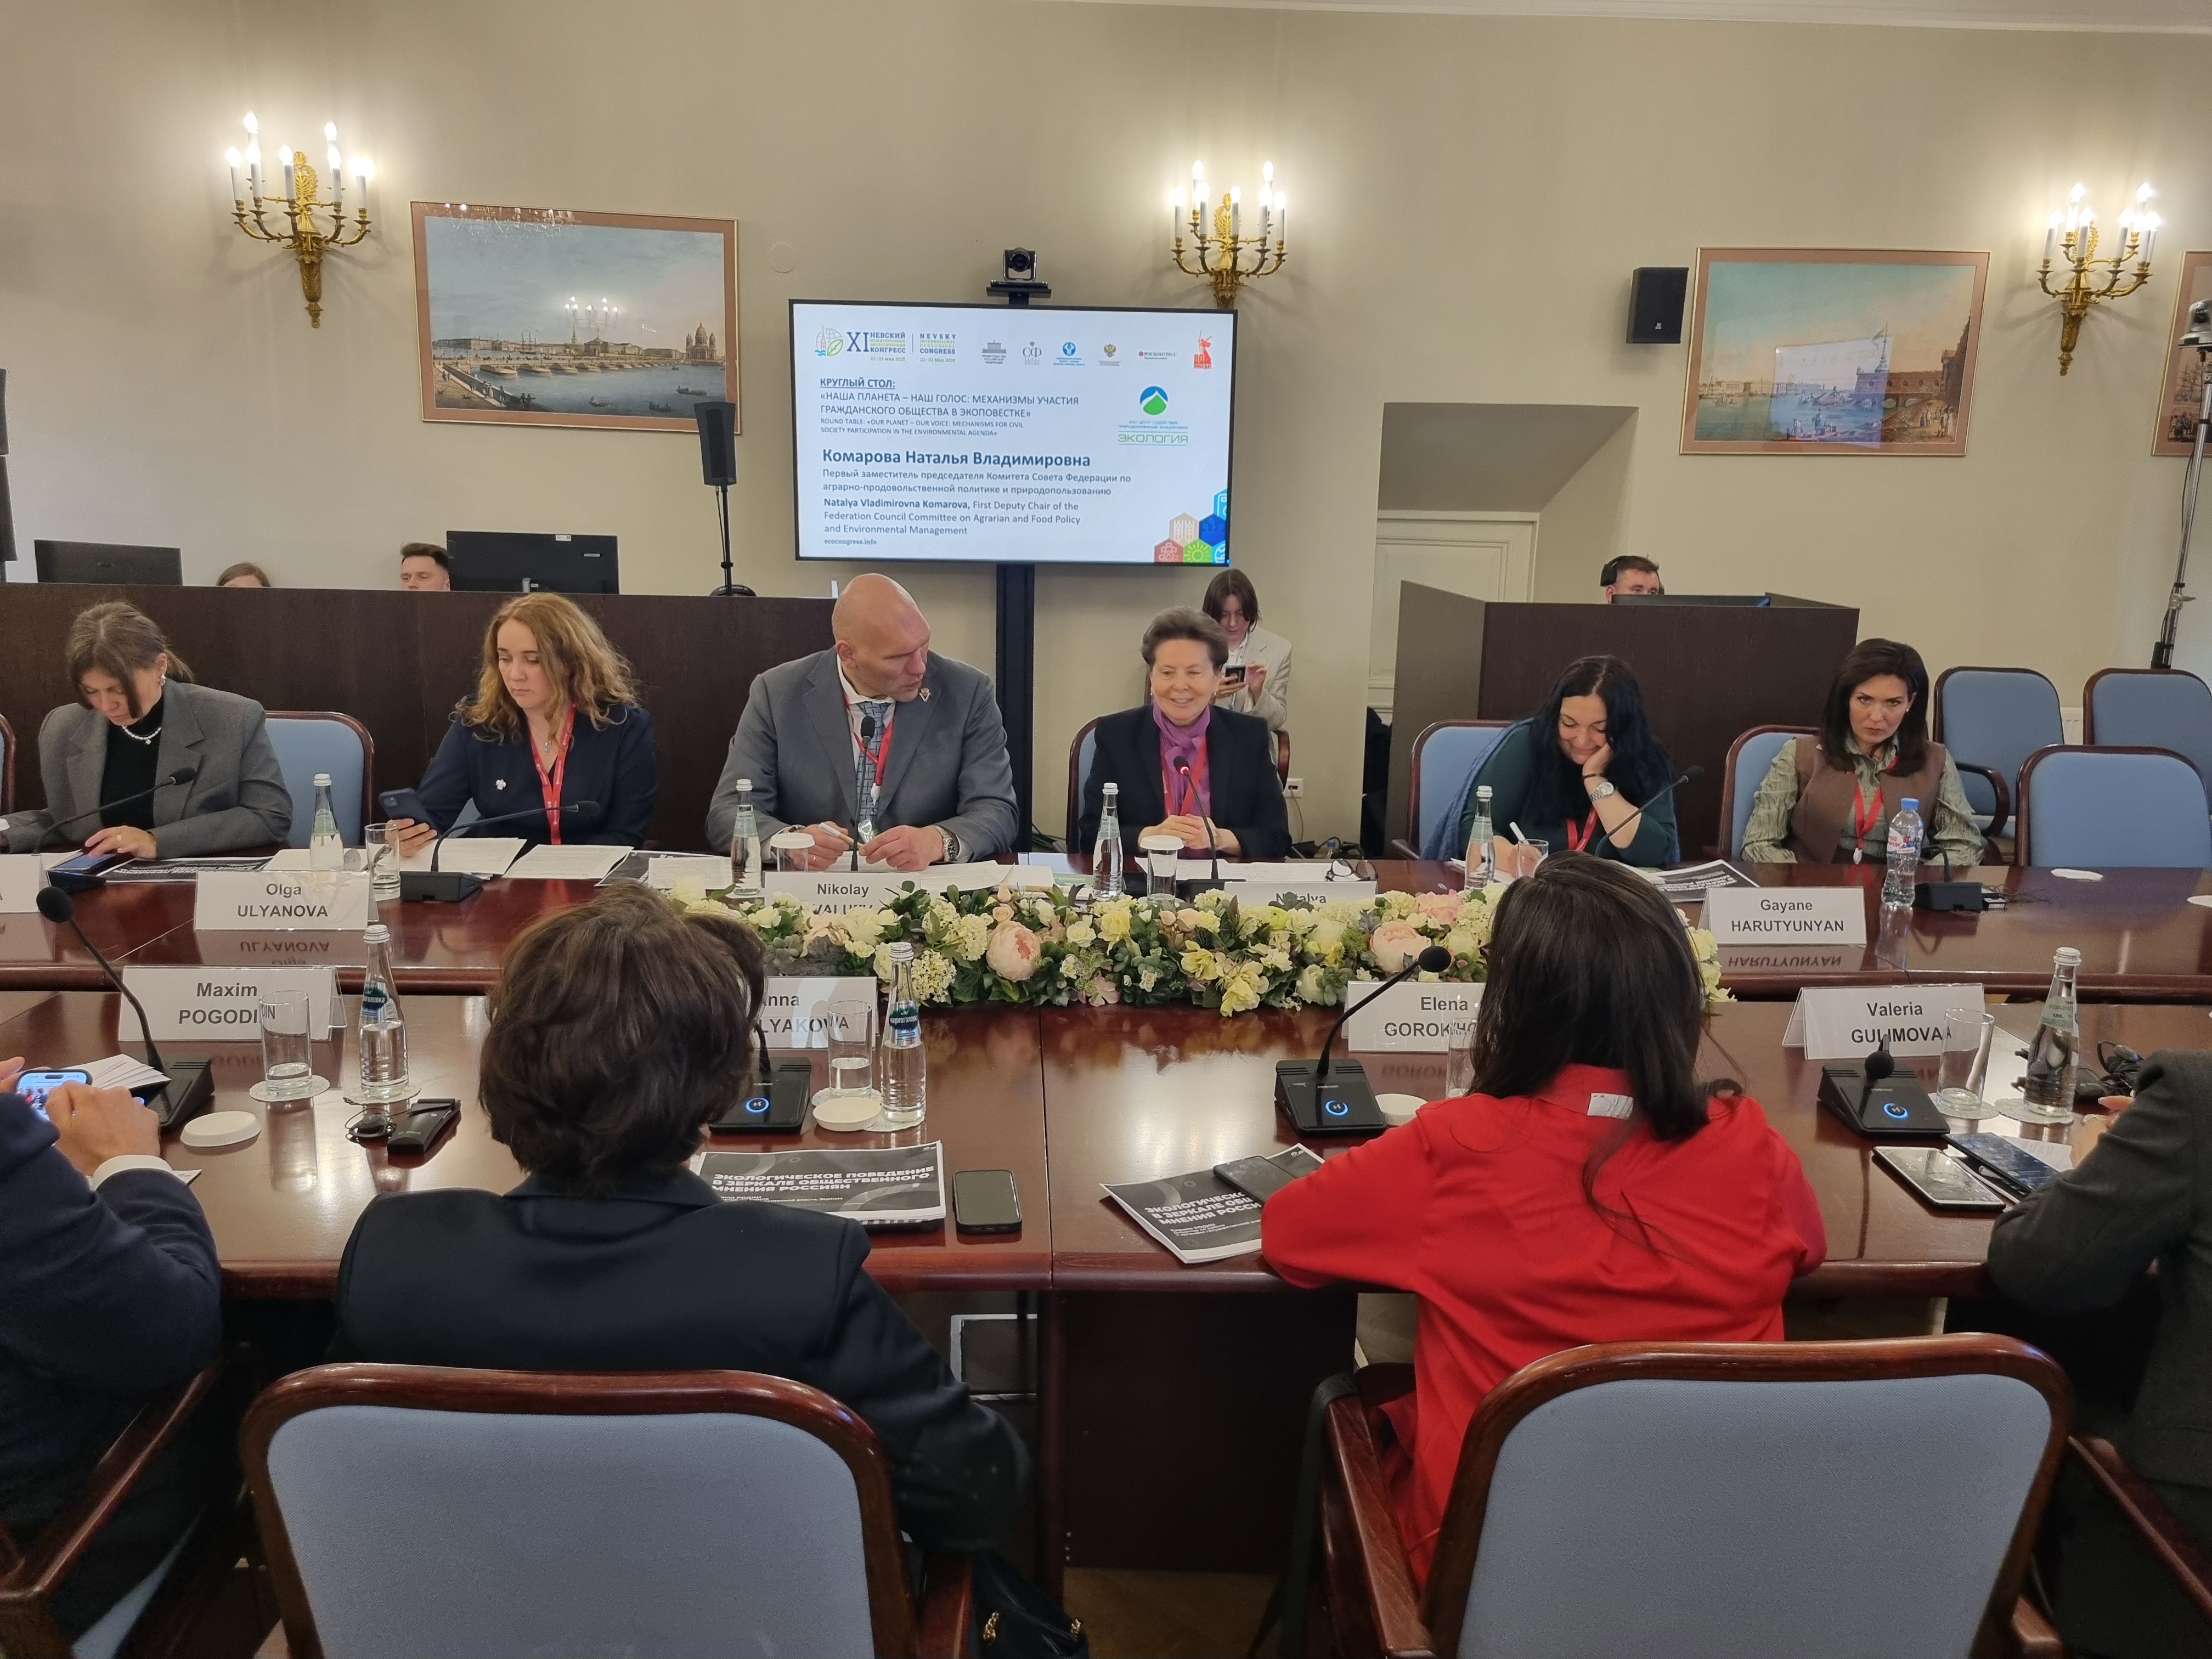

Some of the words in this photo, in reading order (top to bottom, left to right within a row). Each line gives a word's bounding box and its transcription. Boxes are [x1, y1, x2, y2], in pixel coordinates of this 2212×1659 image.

[847, 332, 869, 352] XI
[820, 377, 865, 387] КРУГЛЫЙ
[867, 379, 895, 388] СТОЛ:
[821, 392, 855, 400] «НАША
[857, 393, 900, 402] ПЛАНЕТА
[911, 394, 933, 402] НАШ
[936, 394, 969, 403] ГОЛОС:
[972, 396, 1035, 404] МЕХАНИЗМЫ
[1037, 397, 1079, 405] УЧАСТИЯ
[821, 405, 895, 415] ГРАЖДАНСКОГО
[898, 407, 949, 417] ОБЩЕСТВА
[960, 408, 1031, 417] ЭКОПОВЕСТКЕ»
[1118, 434, 1188, 444] ЭКОЛОГИЯ
[823, 449, 901, 465] Комарова
[906, 450, 968, 465] Наталья
[973, 452, 1091, 469] Владимировна
[823, 469, 859, 479] Первый
[861, 471, 918, 479] заместитель
[921, 472, 984, 481] председателя
[987, 472, 1029, 481] Комитета
[1032, 473, 1063, 481] Совета
[1065, 473, 1118, 483] Федерации
[823, 483, 955, 493] аграрно-продовольственной
[958, 486, 1000, 494] политике
[1011, 487, 1111, 496] природопользованию
[824, 498, 858, 508] Natalya
[861, 499, 920, 508] Vladimirovna
[923, 500, 970, 510] Komarova,
[973, 501, 991, 510] First
[994, 501, 1025, 511] Deputy
[1028, 501, 1051, 510] Chair
[1053, 502, 1063, 510] of
[1064, 502, 1079, 510] the
[824, 512, 871, 520] Federation
[874, 512, 906, 521] Council
[909, 512, 957, 522] Committee
[973, 514, 1010, 523] Agrarian
[1013, 515, 1029, 523] and
[1031, 515, 1053, 523] Food
[1056, 515, 1081, 525] Policy
[824, 524, 840, 533] and
[843, 525, 907, 534] Environmental
[909, 526, 968, 536] Management
[266, 883, 302, 898] Olga
[817, 883, 870, 898] Nikolay
[238, 905, 329, 917] ULYANOVA
[1760, 899, 1813, 913] Gayane
[1731, 920, 1844, 932] HARUTYUNYAN
[196, 982, 258, 997] Maxim
[764, 995, 800, 1007] nna
[1420, 996, 1469, 1011] Elena
[1866, 1002, 1923, 1017] Valeria
[846, 1166, 934, 1178] ПОВЕДЕНИЕ
[798, 1173, 930, 1185] ОБЩЕСТВЕННОГО
[1159, 1211, 1216, 1224] МНЕНИЯ
[1216, 1202, 1262, 1216] РОССИ
[1163, 1202, 1225, 1218] ЗЕРКАЛЕ
